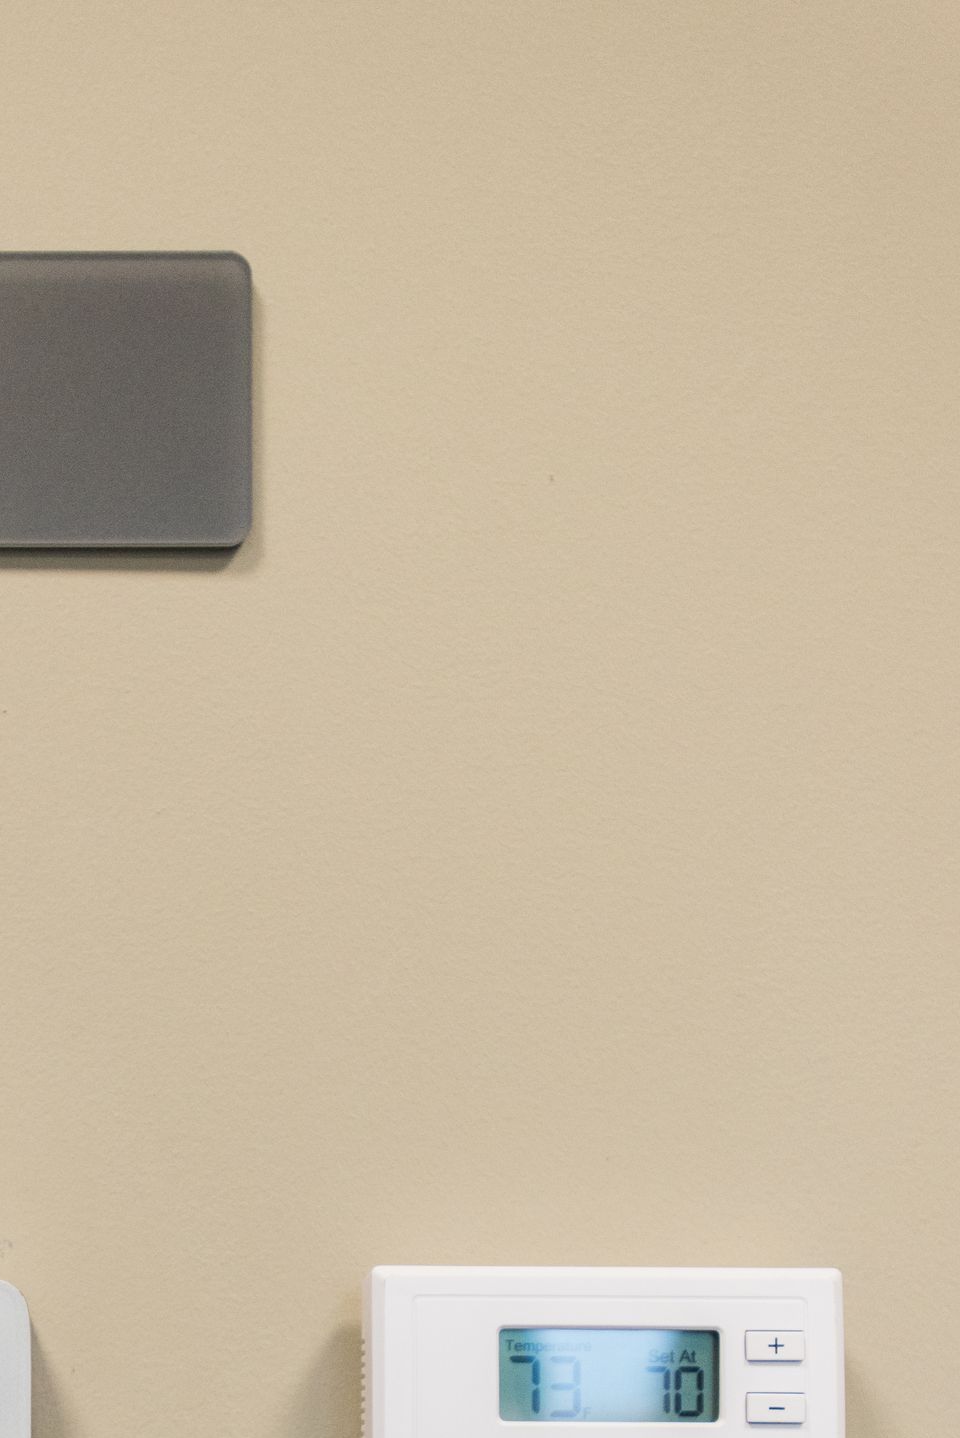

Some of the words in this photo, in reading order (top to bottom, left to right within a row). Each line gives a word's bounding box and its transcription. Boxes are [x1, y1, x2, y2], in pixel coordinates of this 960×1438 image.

[648, 1350, 675, 1364] Set
[679, 1350, 697, 1363] At
[510, 1355, 581, 1417] 73
[644, 1366, 704, 1417] 70
